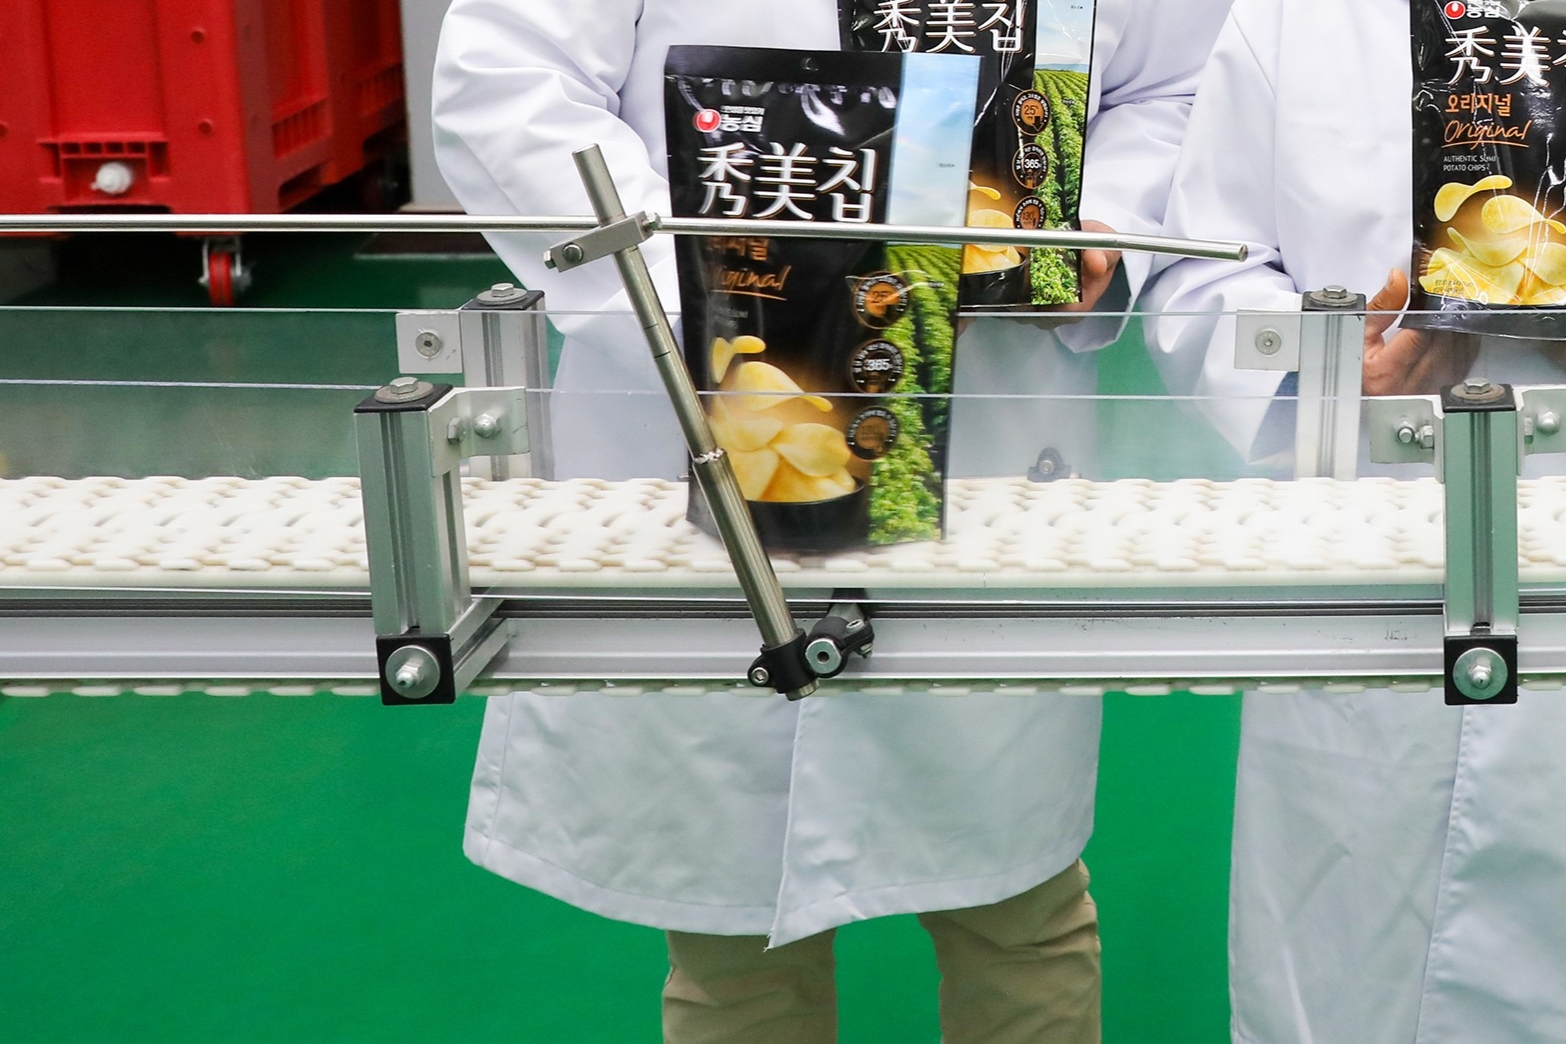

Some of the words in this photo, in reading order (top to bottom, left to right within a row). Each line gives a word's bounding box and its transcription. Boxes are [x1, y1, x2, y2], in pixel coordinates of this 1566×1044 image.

[1445, 94, 1512, 117] 오리지널
[720, 114, 764, 132] 농심
[1444, 118, 1533, 150] Original
[1443, 164, 1466, 172] POTATO
[1468, 164, 1486, 172] CHIPS
[697, 142, 879, 224] 秀美칩
